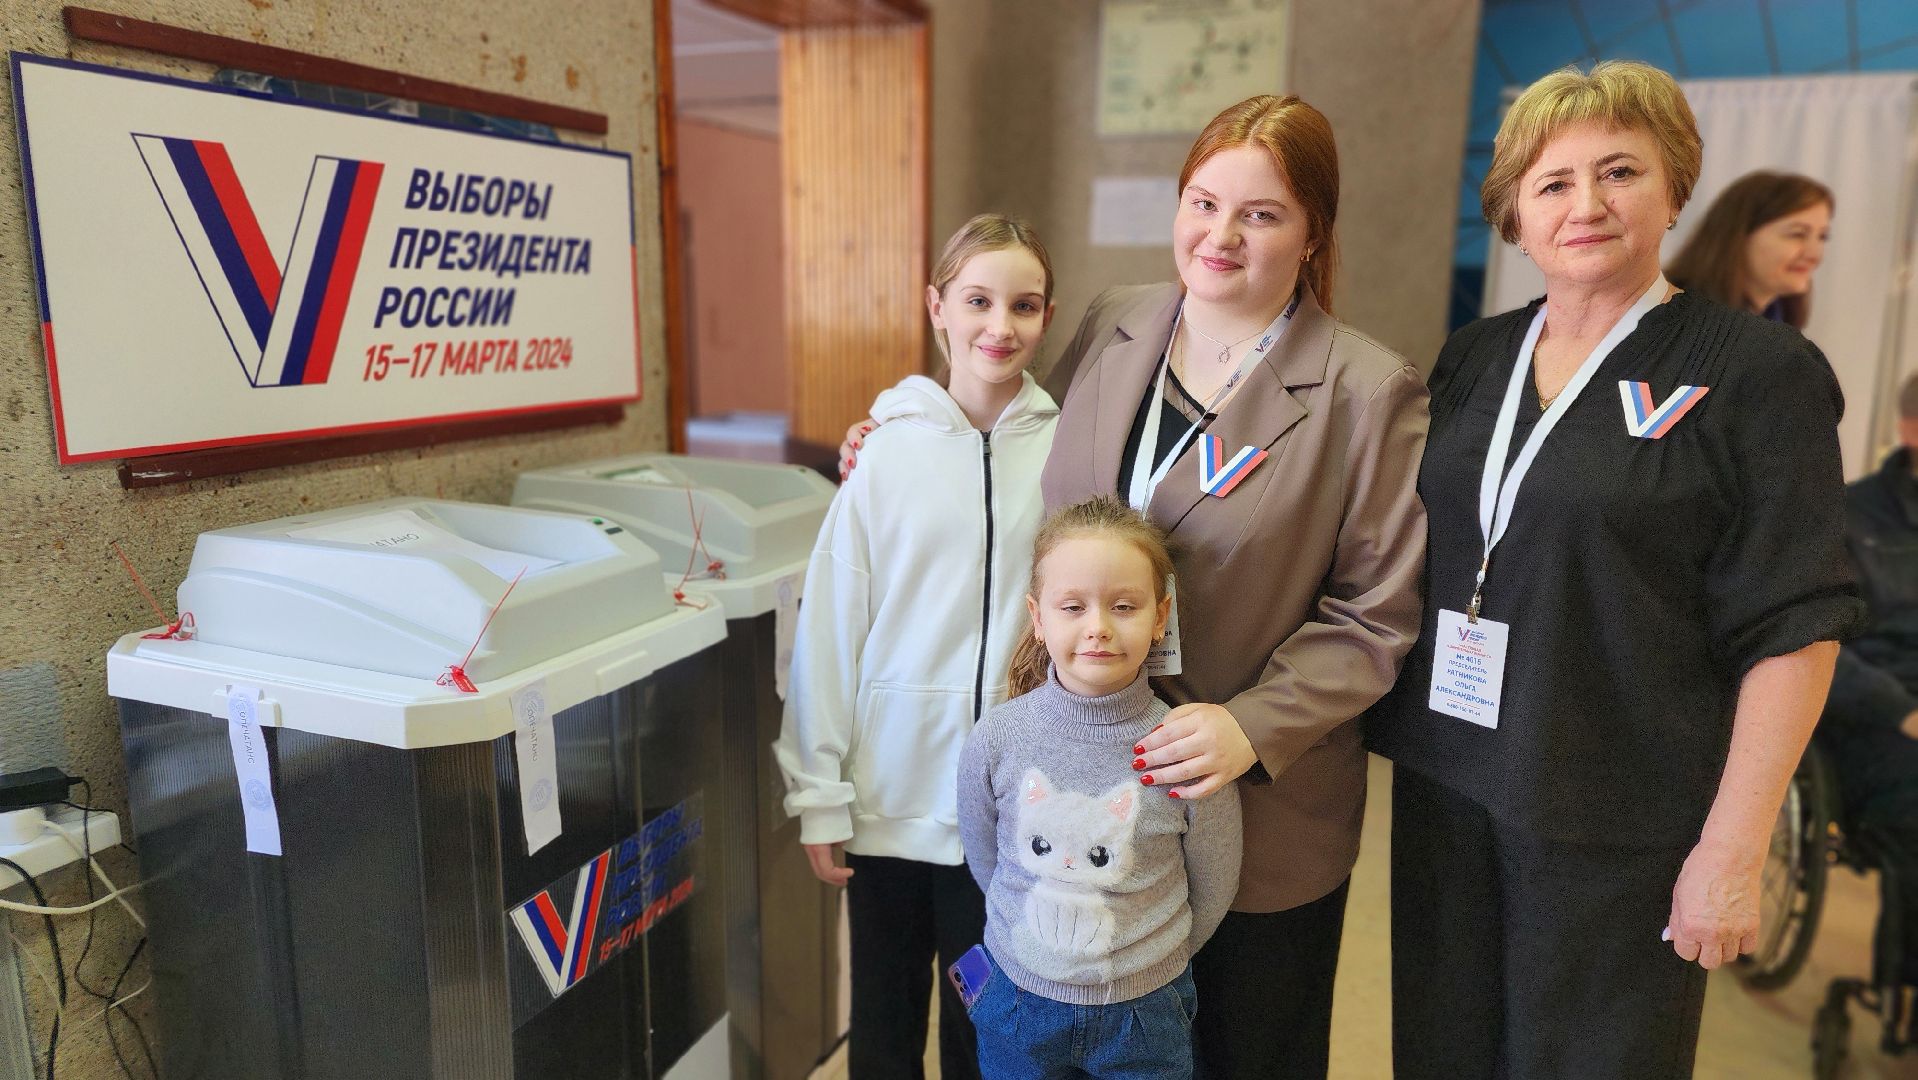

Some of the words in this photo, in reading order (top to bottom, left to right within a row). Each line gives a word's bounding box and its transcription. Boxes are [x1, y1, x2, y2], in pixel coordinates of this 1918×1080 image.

[404, 168, 553, 221] ВЫБОРЫ
[389, 227, 592, 279] ПРЕЗИДЕНТА
[373, 286, 516, 329] РОССИИ
[439, 339, 519, 377] МАРТА
[522, 337, 573, 372] 2024
[1435, 685, 1495, 707] АЛЕКСАНДРОВНА
[1454, 681, 1476, 692] ОЛЬГА
